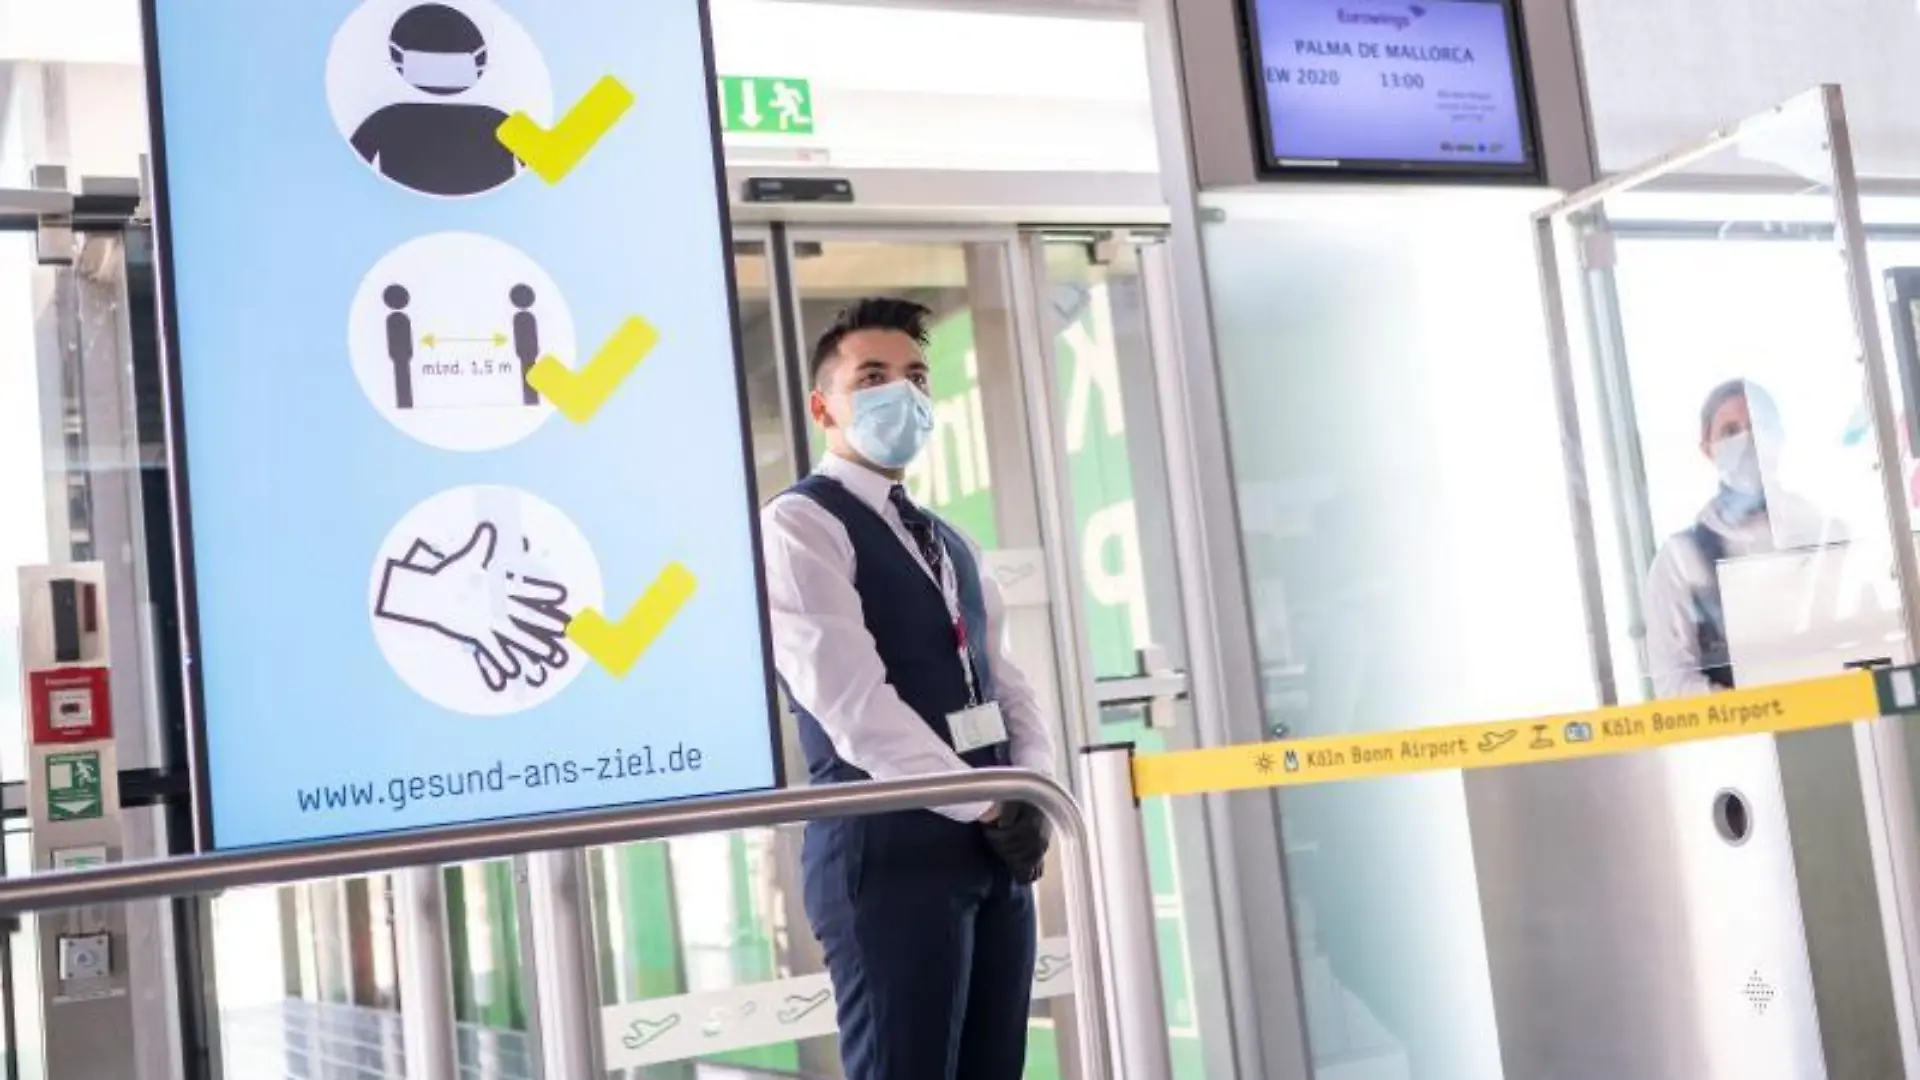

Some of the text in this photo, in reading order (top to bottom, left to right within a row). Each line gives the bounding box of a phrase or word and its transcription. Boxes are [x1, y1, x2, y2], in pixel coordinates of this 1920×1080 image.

[1295, 39, 1475, 63] PALMA DE MALLORCA
[1266, 67, 1424, 89] EW 2020 13:00
[422, 359, 465, 376] mind.
[498, 362, 512, 374] m
[1307, 699, 1785, 769] Köln Bonn Airport Köln Bonn Airport
[297, 742, 703, 813] www.gesund-ans-ziel.de
